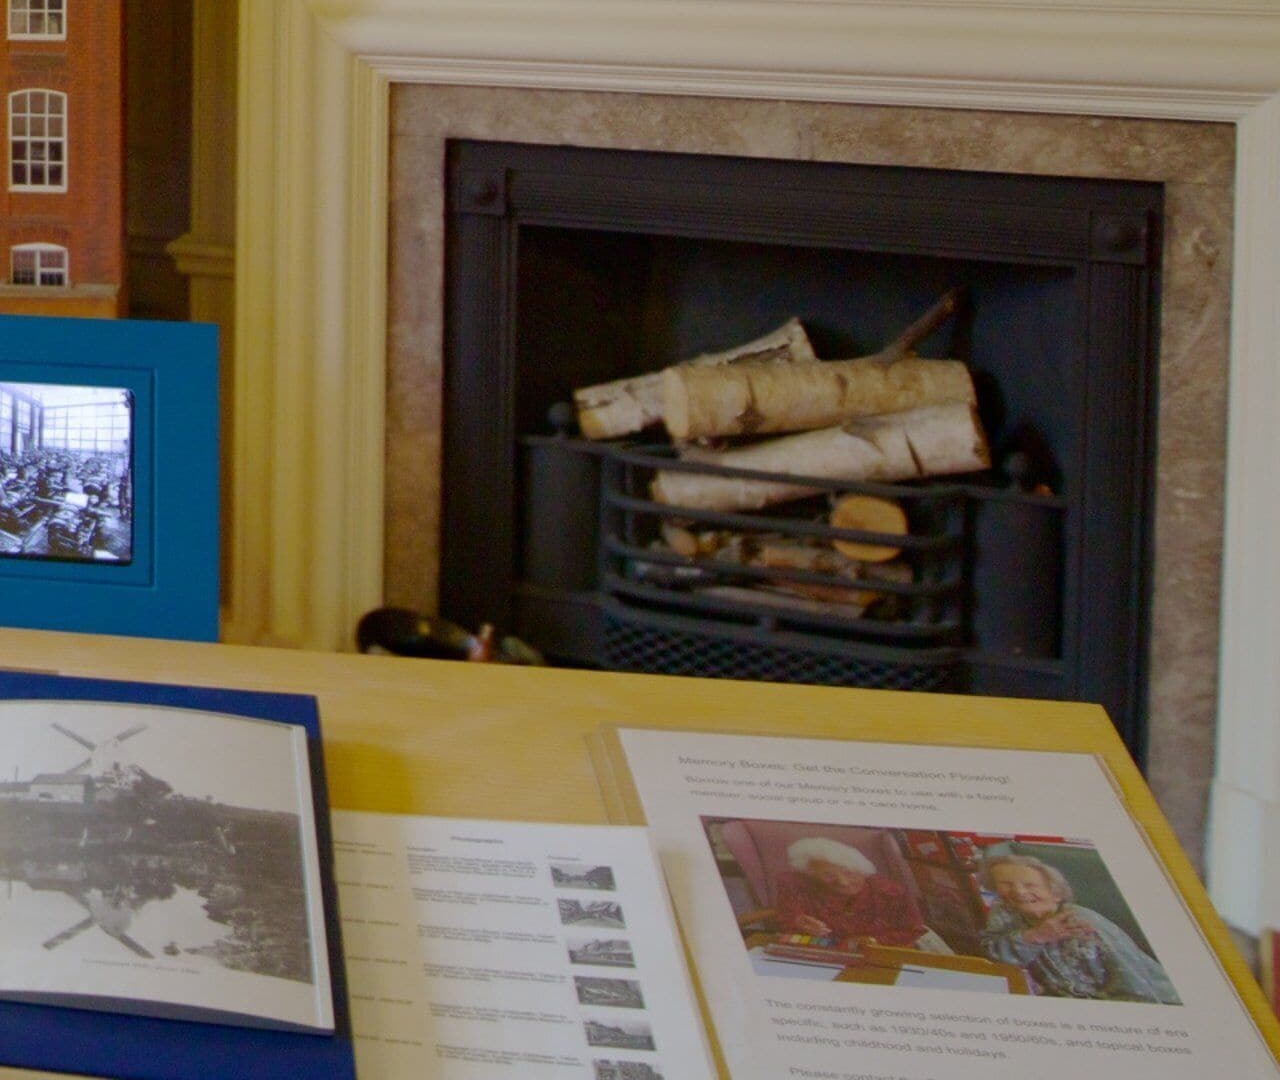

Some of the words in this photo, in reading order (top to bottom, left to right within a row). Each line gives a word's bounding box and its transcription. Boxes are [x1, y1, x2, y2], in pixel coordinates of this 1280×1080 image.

[678, 756, 736, 769] Memory
[823, 764, 846, 774] the
[849, 766, 946, 781] Conversation
[765, 998, 792, 1009] The
[796, 1001, 866, 1017] constantly
[870, 1008, 926, 1021] growing
[929, 1011, 991, 1025] selection
[996, 1016, 1009, 1025] of
[1013, 1017, 1057, 1029] boxes
[1077, 1023, 1086, 1032] a
[1090, 1023, 1143, 1035] mixture
[1147, 1026, 1161, 1036] of
[776, 1033, 840, 1048] including
[844, 1038, 912, 1053] childhood
[916, 1043, 944, 1055] and
[832, 1021, 867, 1032] such
[870, 1025, 888, 1034] as
[960, 1030, 986, 1041] and
[1065, 1037, 1093, 1049] and
[1096, 1039, 1143, 1053] topical
[1147, 1042, 1193, 1056] boxes
[789, 1065, 838, 1079] Please
